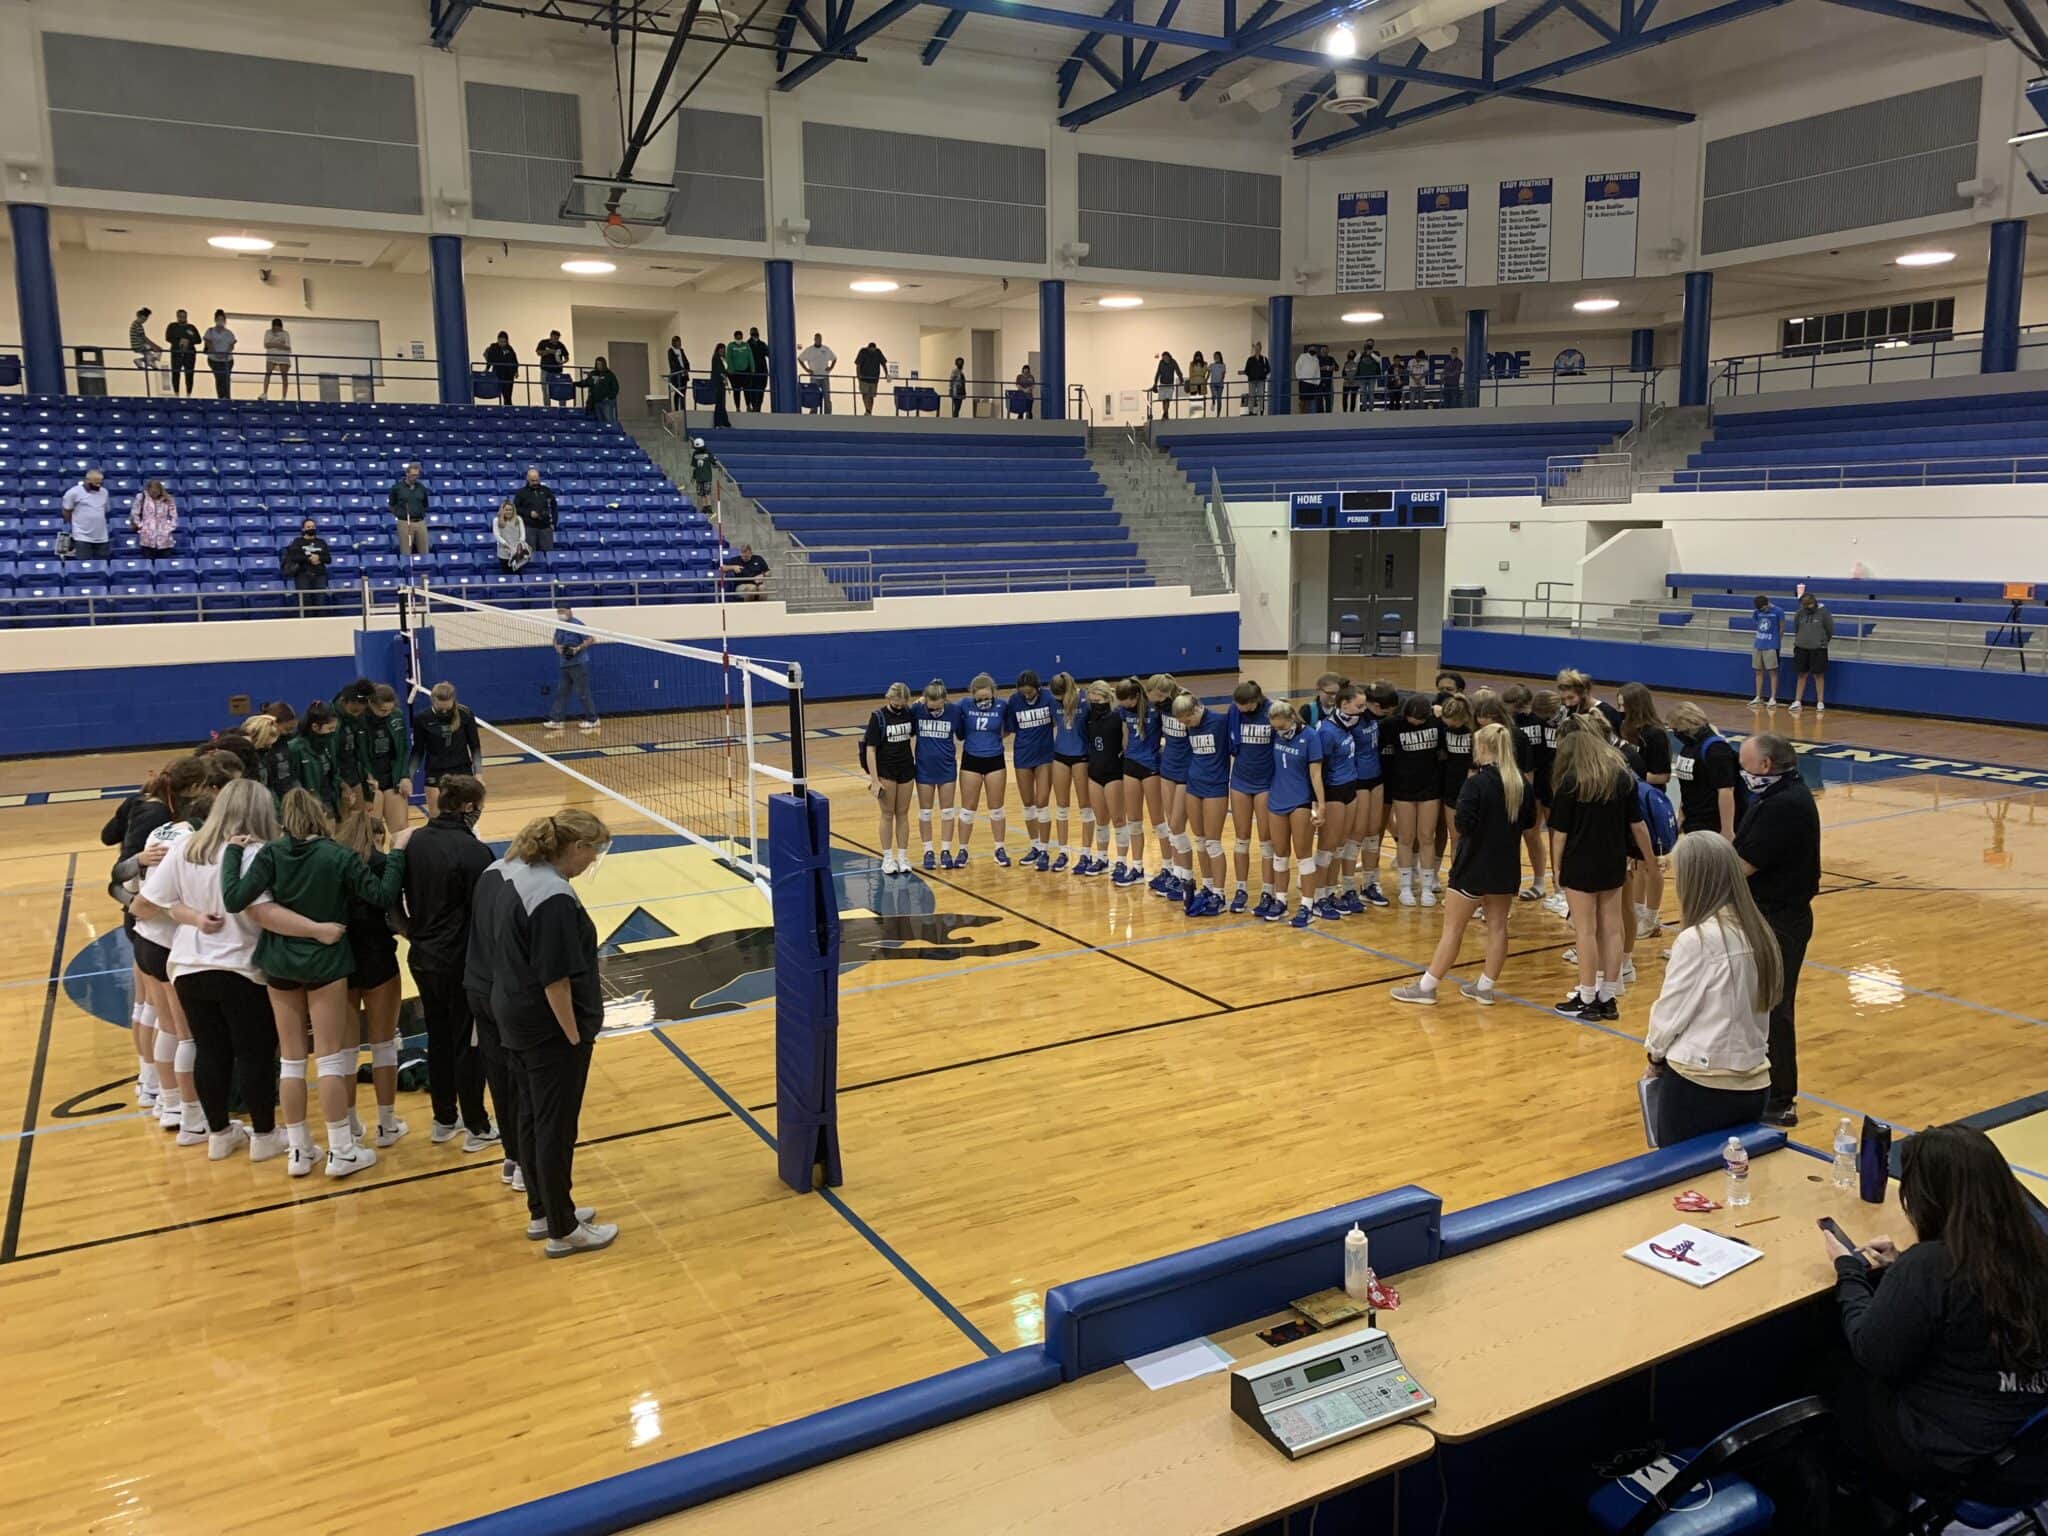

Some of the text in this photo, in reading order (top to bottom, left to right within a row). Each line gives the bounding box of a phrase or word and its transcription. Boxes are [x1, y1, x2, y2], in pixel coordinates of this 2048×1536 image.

[1502, 178, 1550, 189] LADY PANTHERS
[1588, 171, 1638, 183] LADY PANTHERS
[1420, 184, 1467, 195] LADY PANTHERS
[1297, 492, 1441, 505] HOME GUEST
[918, 719, 951, 732] PANTHER
[976, 717, 989, 731] 12
[1400, 727, 1438, 745] PANTHER
[1094, 736, 1104, 751] 6
[1281, 752, 1287, 769] 1
